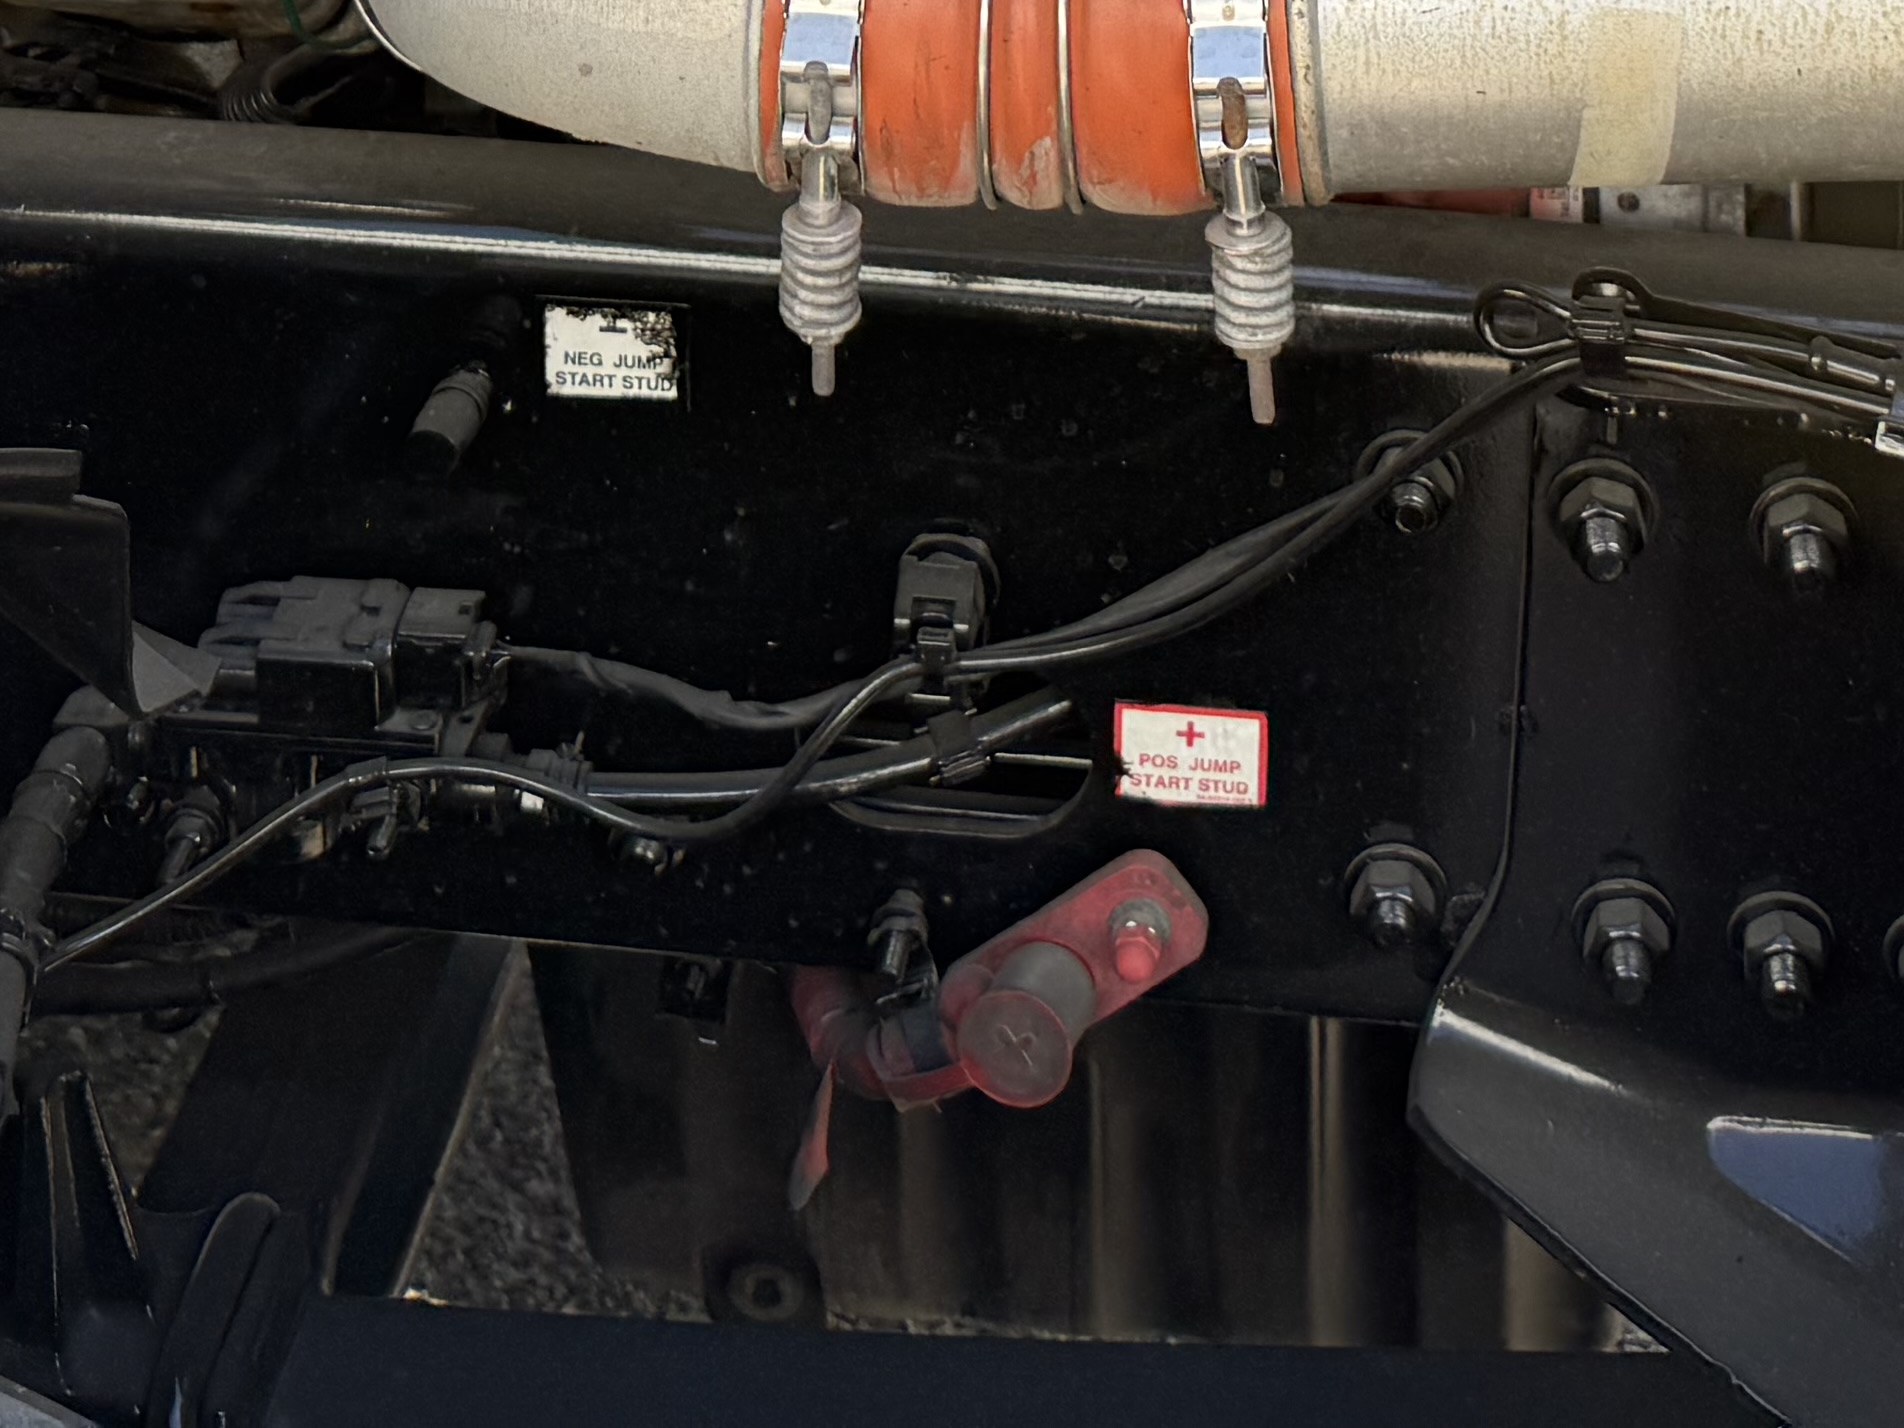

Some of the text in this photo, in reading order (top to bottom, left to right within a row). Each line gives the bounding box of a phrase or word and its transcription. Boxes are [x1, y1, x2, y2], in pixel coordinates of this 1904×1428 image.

[564, 350, 663, 371] NEG JUMP
[555, 371, 673, 392] START STUD
[1139, 753, 1241, 774] POS JUMP
[1129, 773, 1249, 795] START STUD
